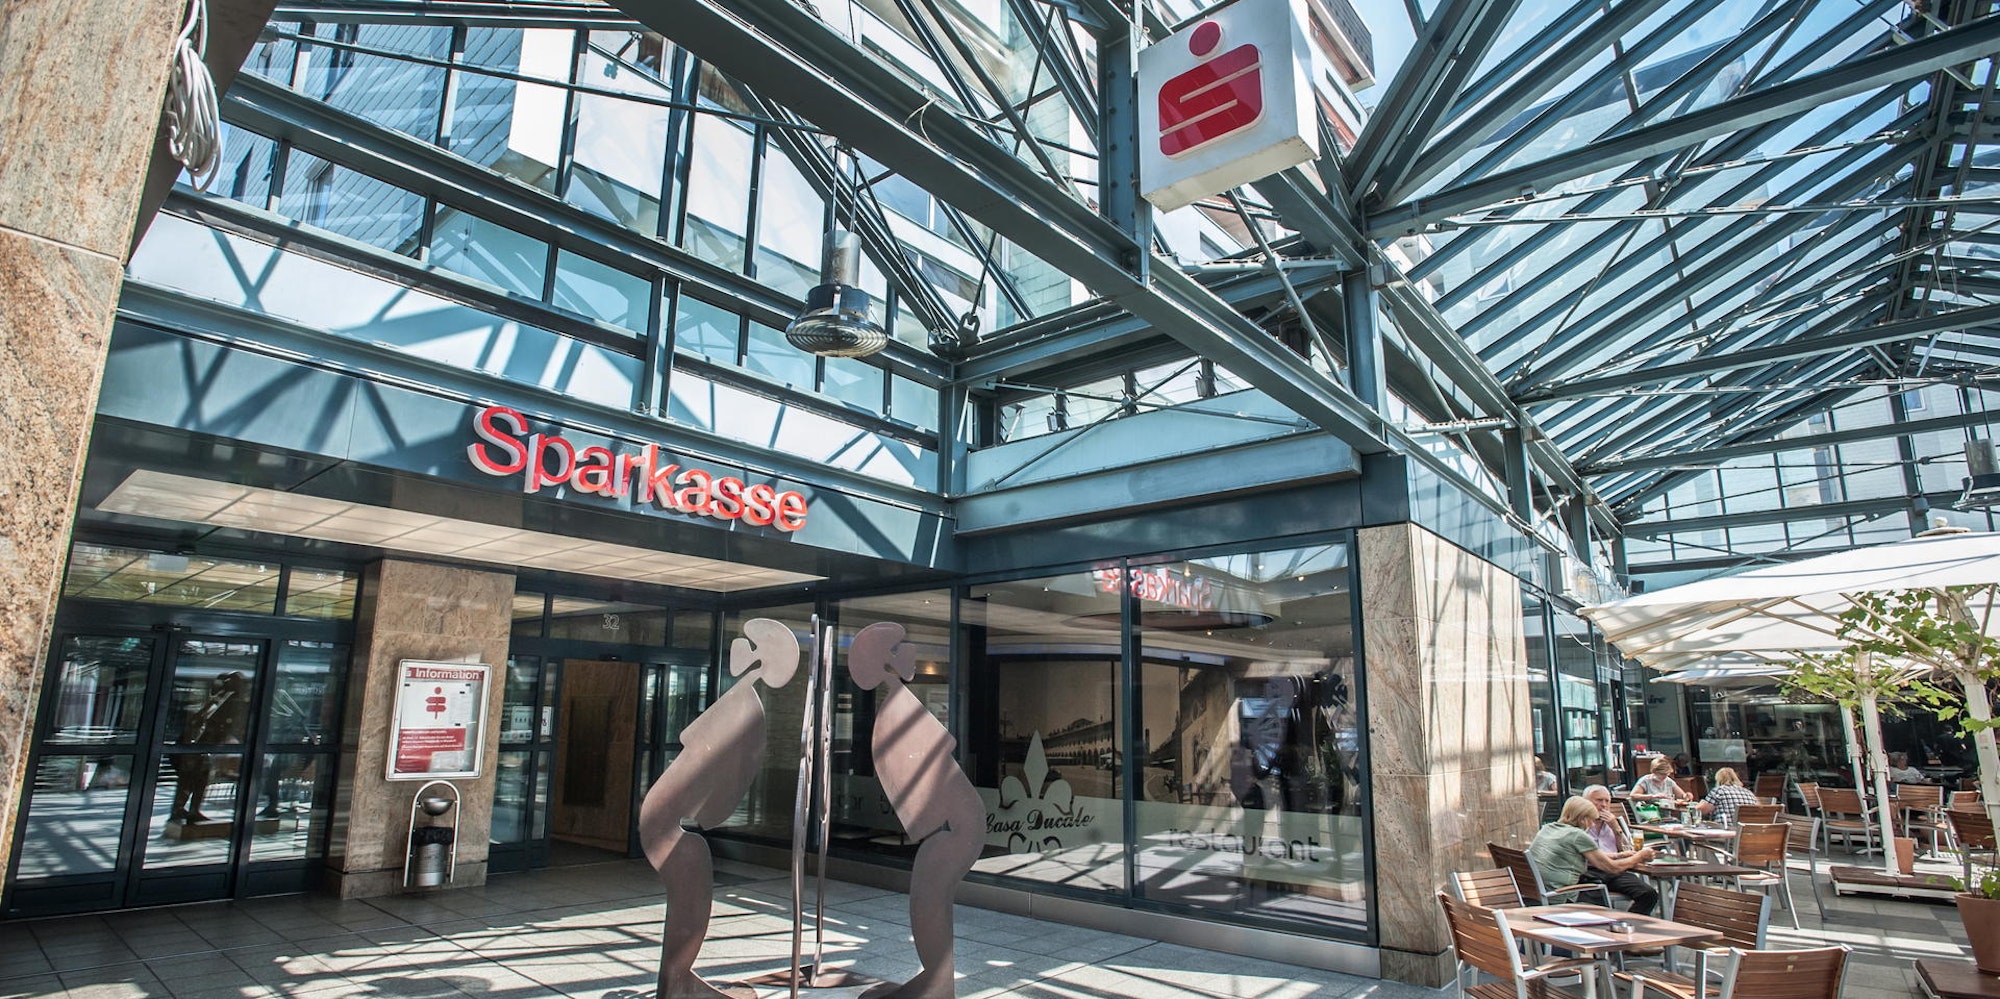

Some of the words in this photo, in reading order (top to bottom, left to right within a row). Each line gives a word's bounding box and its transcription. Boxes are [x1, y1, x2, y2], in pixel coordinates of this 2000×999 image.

[467, 406, 808, 533] Sparkasse
[602, 613, 620, 630] 32
[415, 668, 480, 680] Information
[1026, 807, 1095, 831] Ducale
[1169, 827, 1320, 863] restaurant
